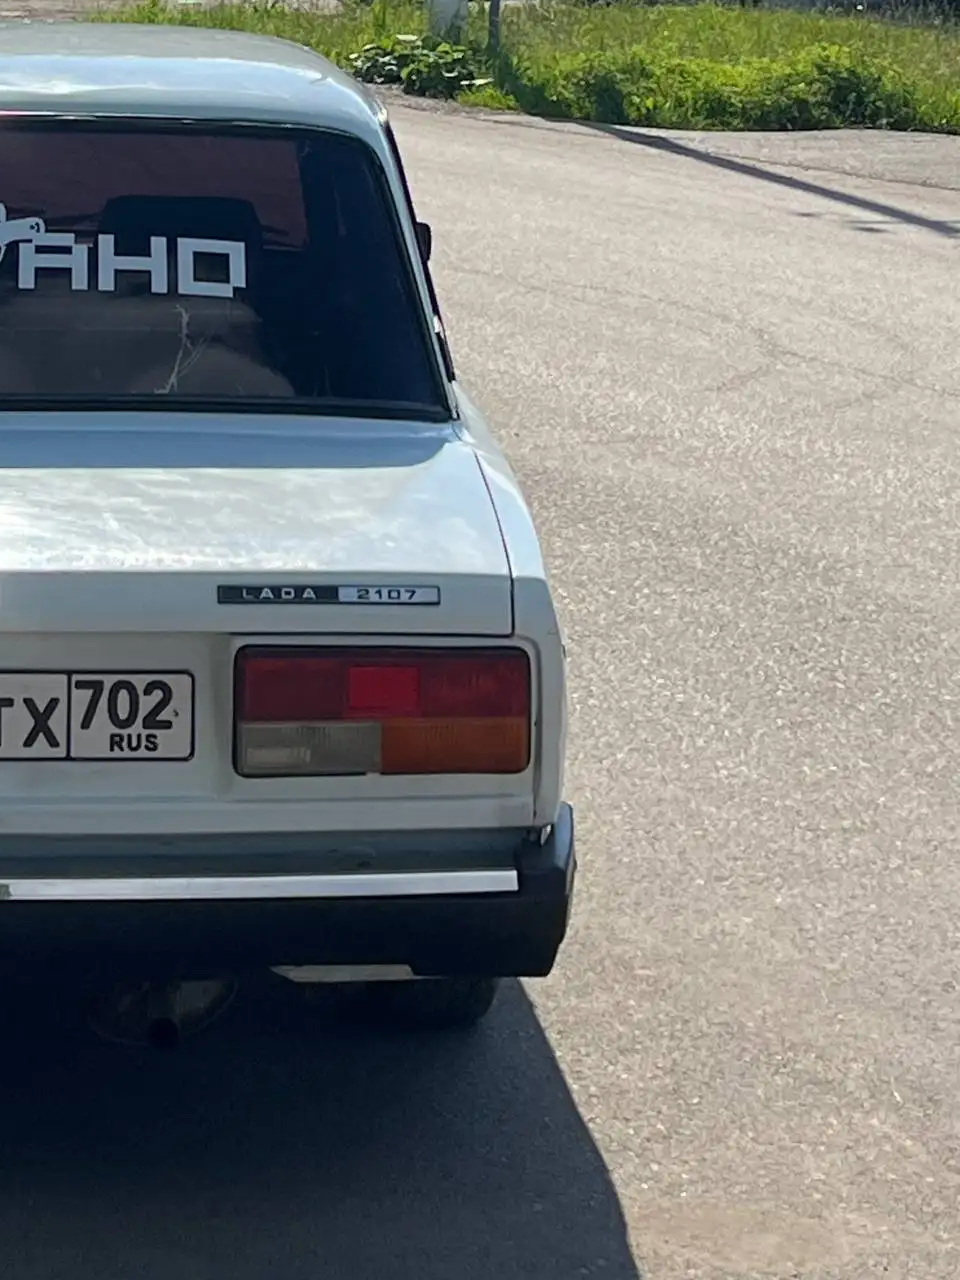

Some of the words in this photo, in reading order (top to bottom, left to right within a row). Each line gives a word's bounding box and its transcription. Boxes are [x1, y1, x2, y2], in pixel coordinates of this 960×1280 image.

[242, 587, 317, 600] LADA
[356, 588, 417, 601] 2107
[74, 679, 174, 730] 702
[109, 733, 160, 753] RUS
